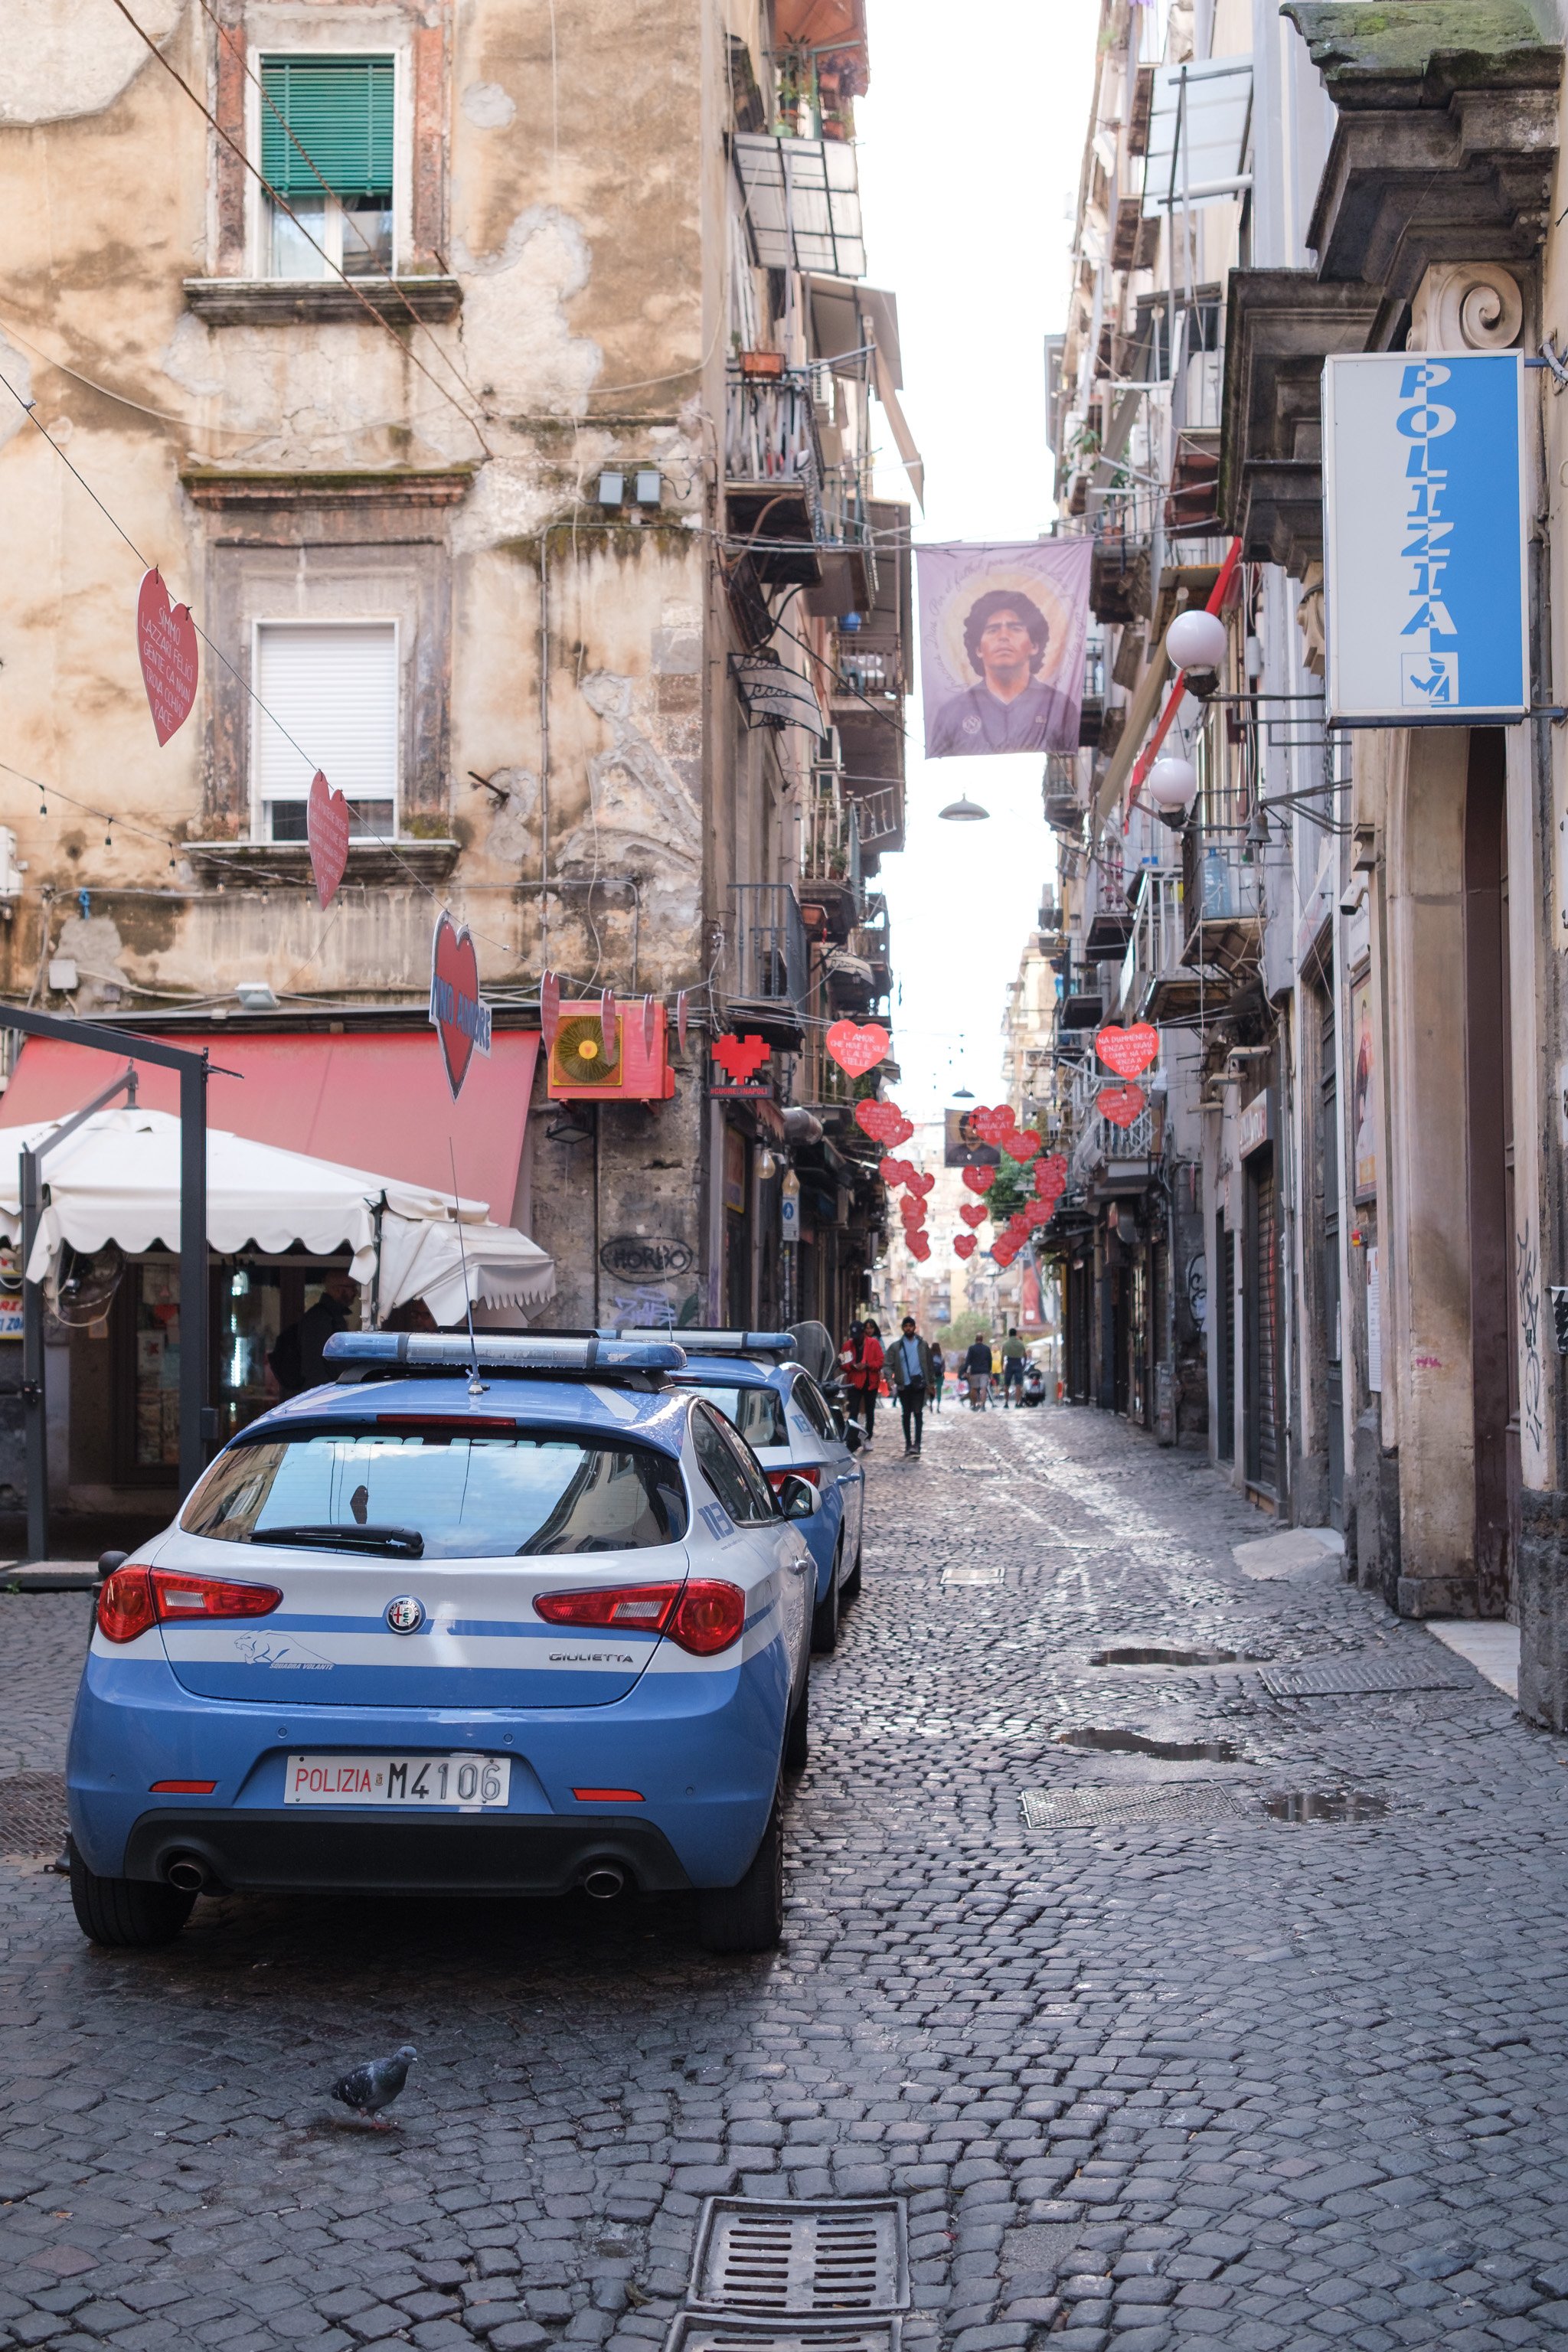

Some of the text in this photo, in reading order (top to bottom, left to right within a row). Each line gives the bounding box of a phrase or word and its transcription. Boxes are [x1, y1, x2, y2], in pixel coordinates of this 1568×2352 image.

[1396, 364, 1458, 635] POLIZIA
[143, 640, 165, 675] GENTE
[144, 663, 163, 697] TROVA
[154, 698, 173, 732] PACE
[456, 990, 491, 1050] AMORE
[842, 1057, 871, 1067] STELLE
[1119, 1064, 1141, 1073] PIZZA
[697, 1501, 735, 1541] 113
[389, 1600, 419, 1616] ALFA ROMEO
[549, 1652, 633, 1663] GIULIETTA
[295, 1762, 500, 1800] POLIZIA M4106
